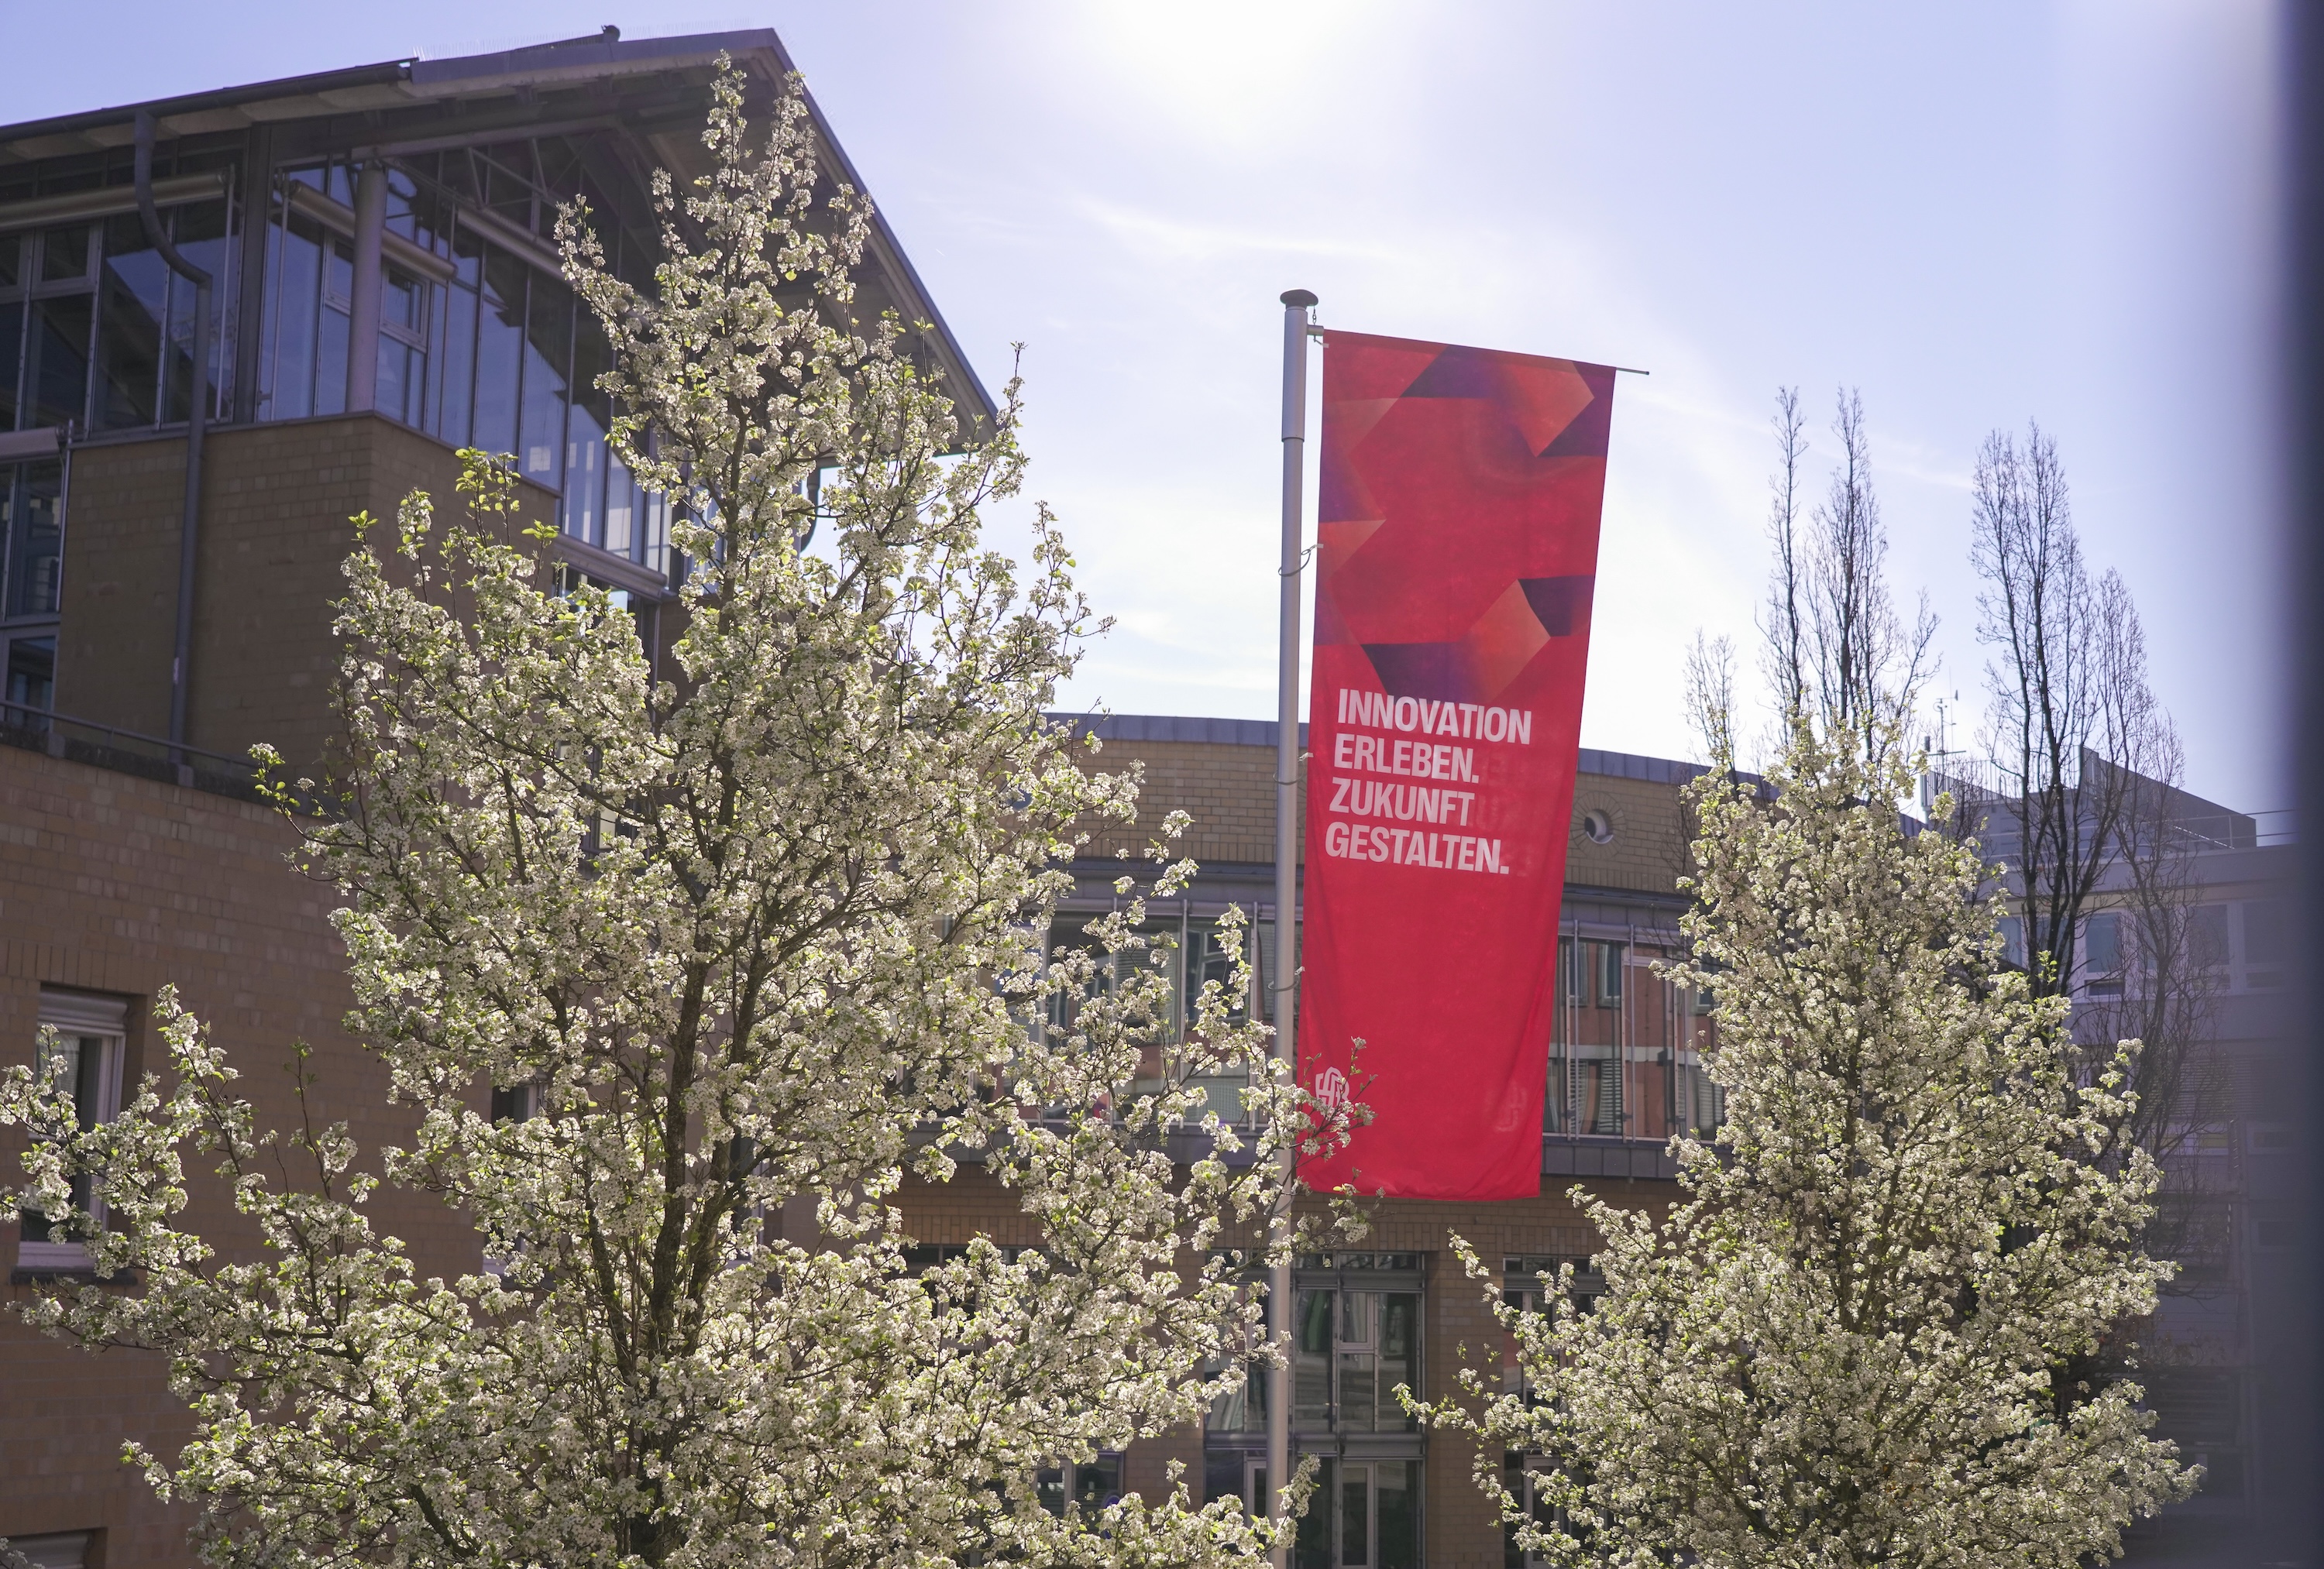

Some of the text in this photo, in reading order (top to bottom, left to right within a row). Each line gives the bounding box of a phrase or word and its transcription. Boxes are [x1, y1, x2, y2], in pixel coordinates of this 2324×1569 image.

[1337, 688, 1532, 744] INNOVATION
[1333, 733, 1479, 784] ERLEBEN.
[1329, 777, 1475, 826] ZUKUNFT
[1325, 822, 1510, 875] GESTALTEN.
